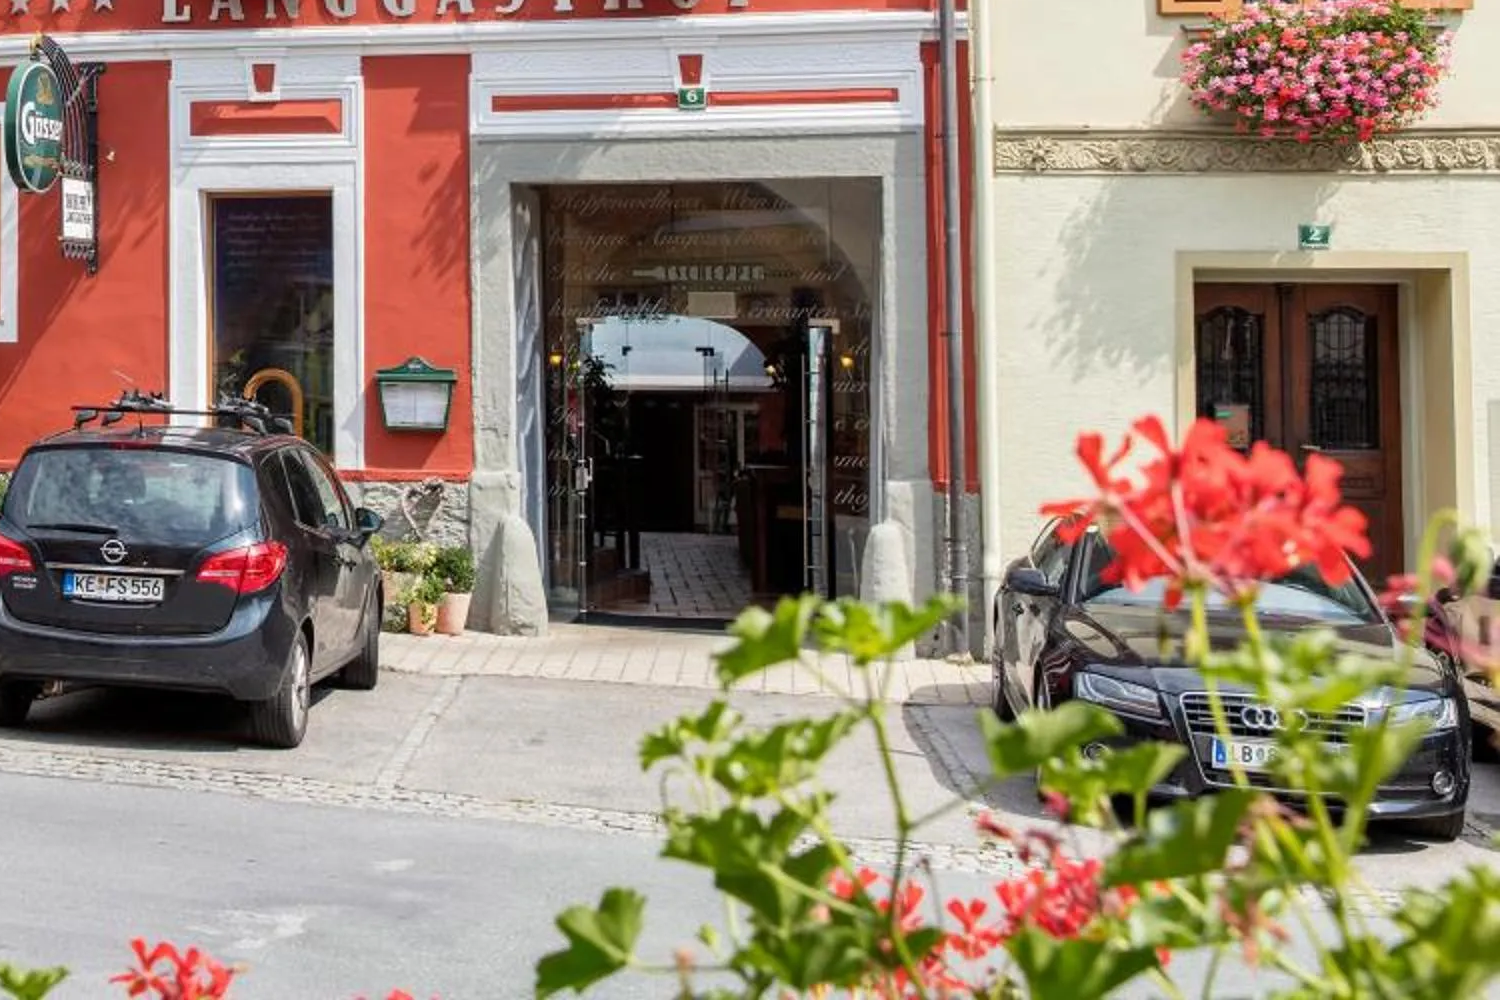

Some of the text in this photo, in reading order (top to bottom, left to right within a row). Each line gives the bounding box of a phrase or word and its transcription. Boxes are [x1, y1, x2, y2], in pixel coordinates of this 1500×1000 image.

[686, 90, 698, 102] 6
[21, 101, 63, 144] Gösse
[1309, 227, 1320, 241] 2
[76, 576, 161, 597] KE FS 556
